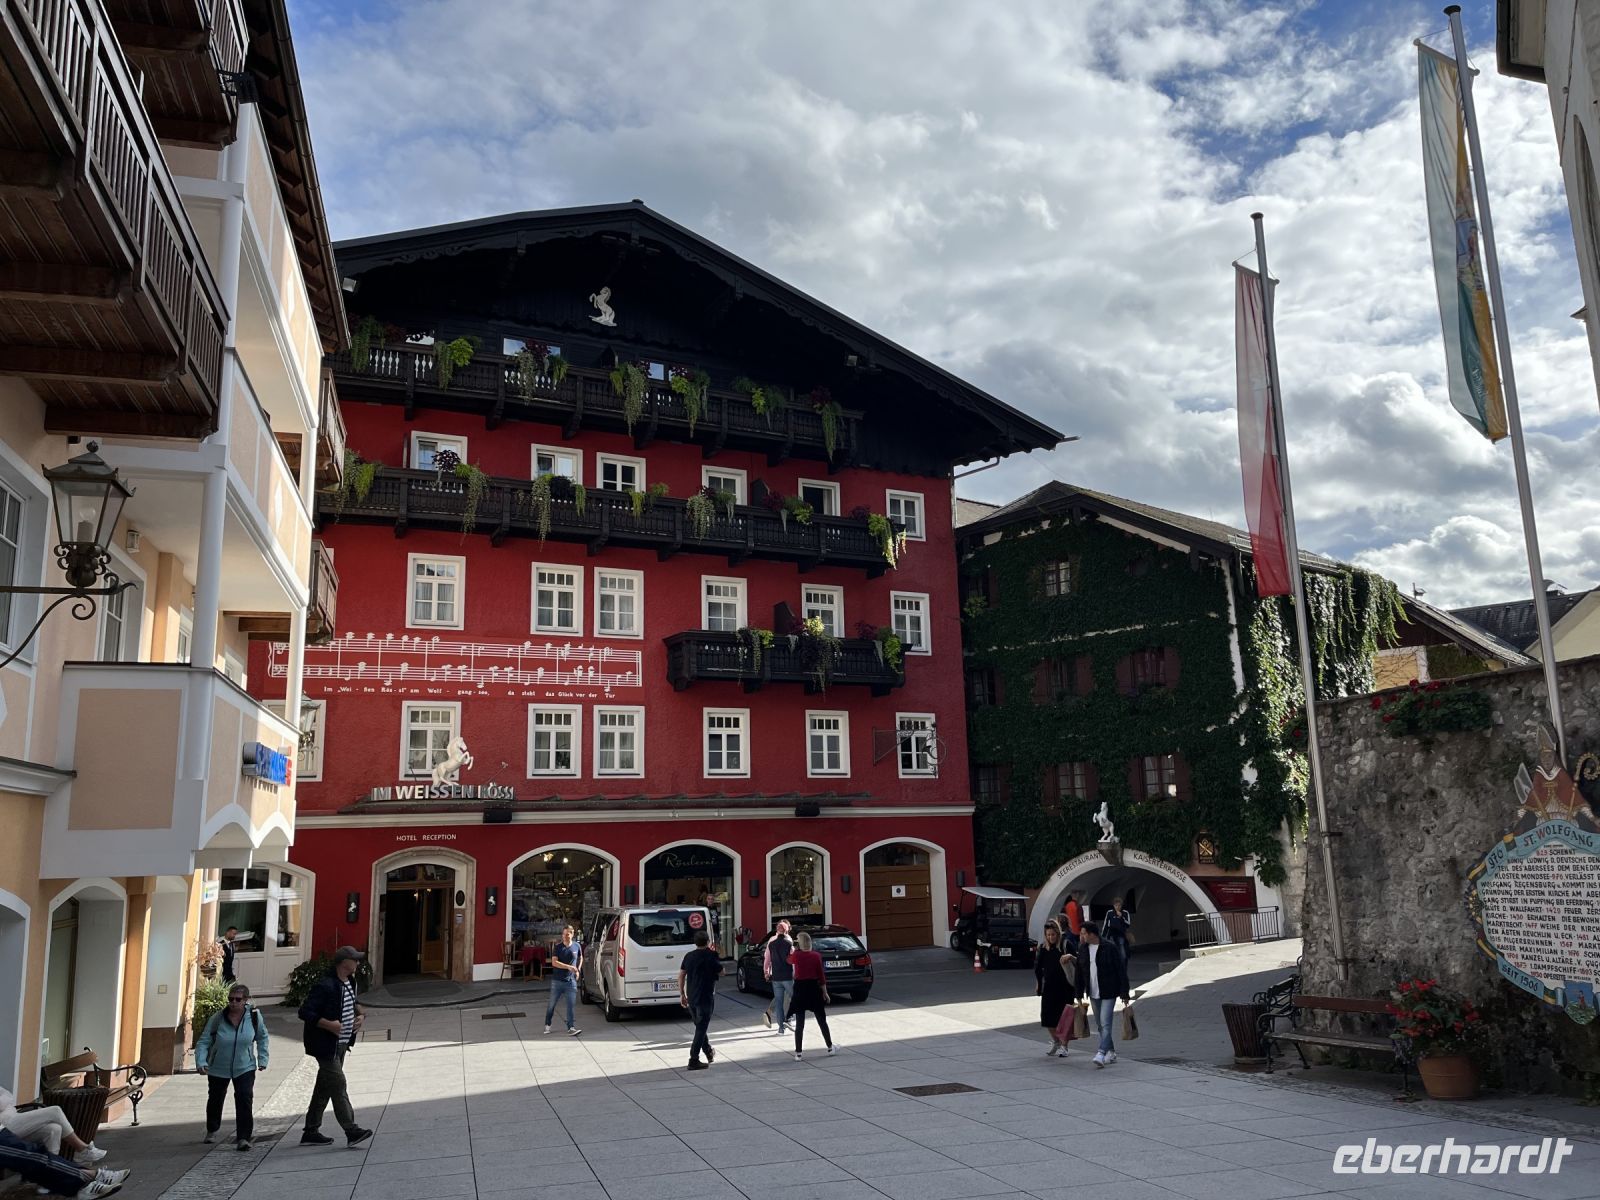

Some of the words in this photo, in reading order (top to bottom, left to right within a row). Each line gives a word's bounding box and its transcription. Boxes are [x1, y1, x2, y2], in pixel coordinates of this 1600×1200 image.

[371, 786, 392, 801] IM
[395, 785, 474, 800] WEISSEN
[1536, 824, 1593, 848] WOLFGANG
[1057, 852, 1103, 879] SEERESTAURANT
[1133, 853, 1187, 883] KAISERTERRASSE
[1514, 881, 1555, 889] REGENSBURG
[1566, 899, 1593, 907] EFERDING
[1519, 946, 1558, 955] MAXIMILIAN
[1521, 953, 1544, 961] KANZEL
[1502, 964, 1519, 979] SEIT
